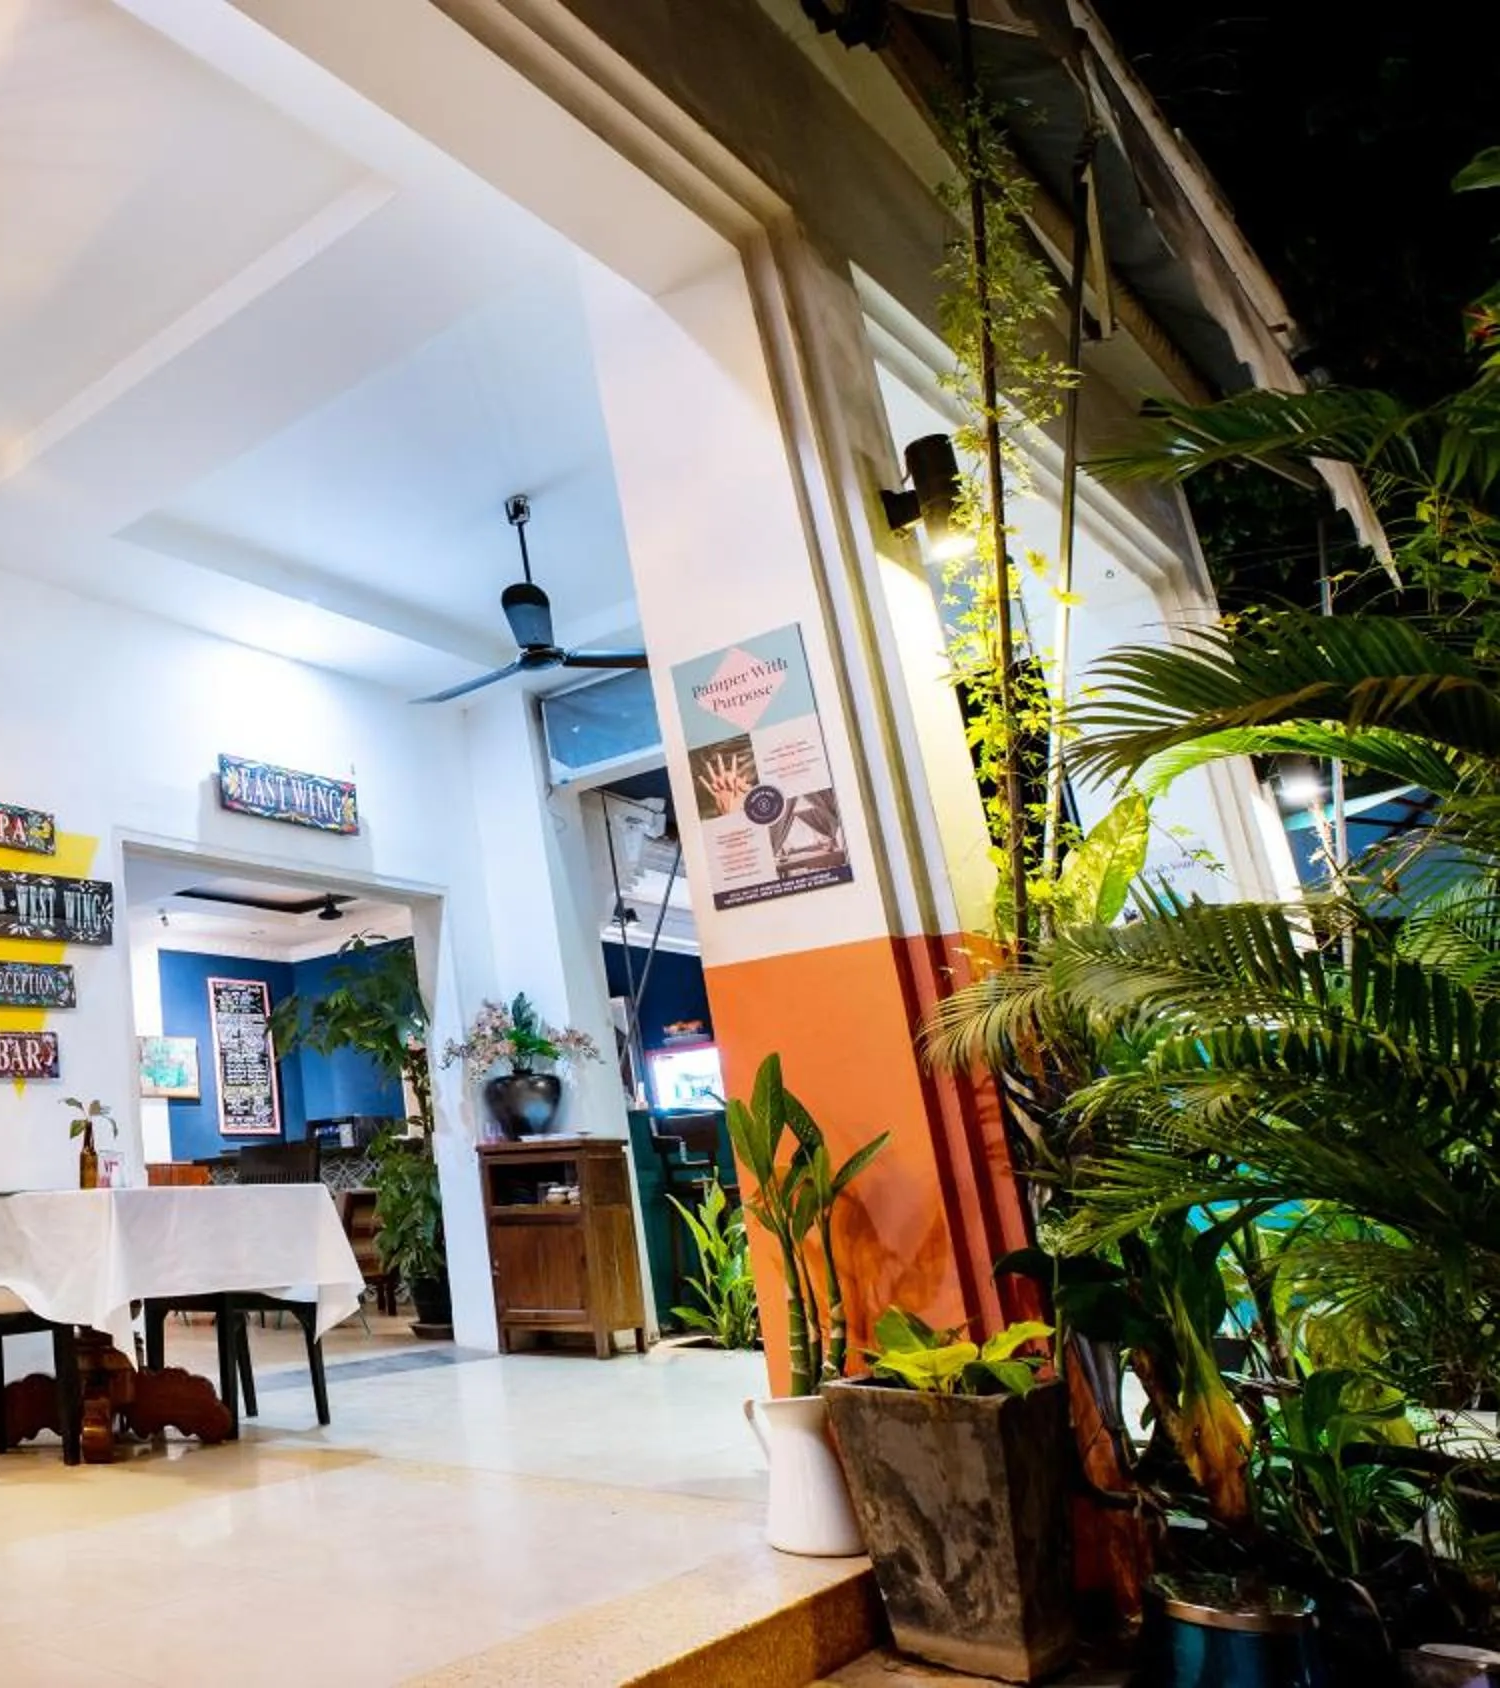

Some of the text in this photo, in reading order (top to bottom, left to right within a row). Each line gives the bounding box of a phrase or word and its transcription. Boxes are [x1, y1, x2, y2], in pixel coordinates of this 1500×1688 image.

[691, 657, 788, 699] Pamper With
[712, 684, 773, 712] Purpose
[239, 767, 341, 822] EAST WING
[16, 883, 101, 930] WEST WING
